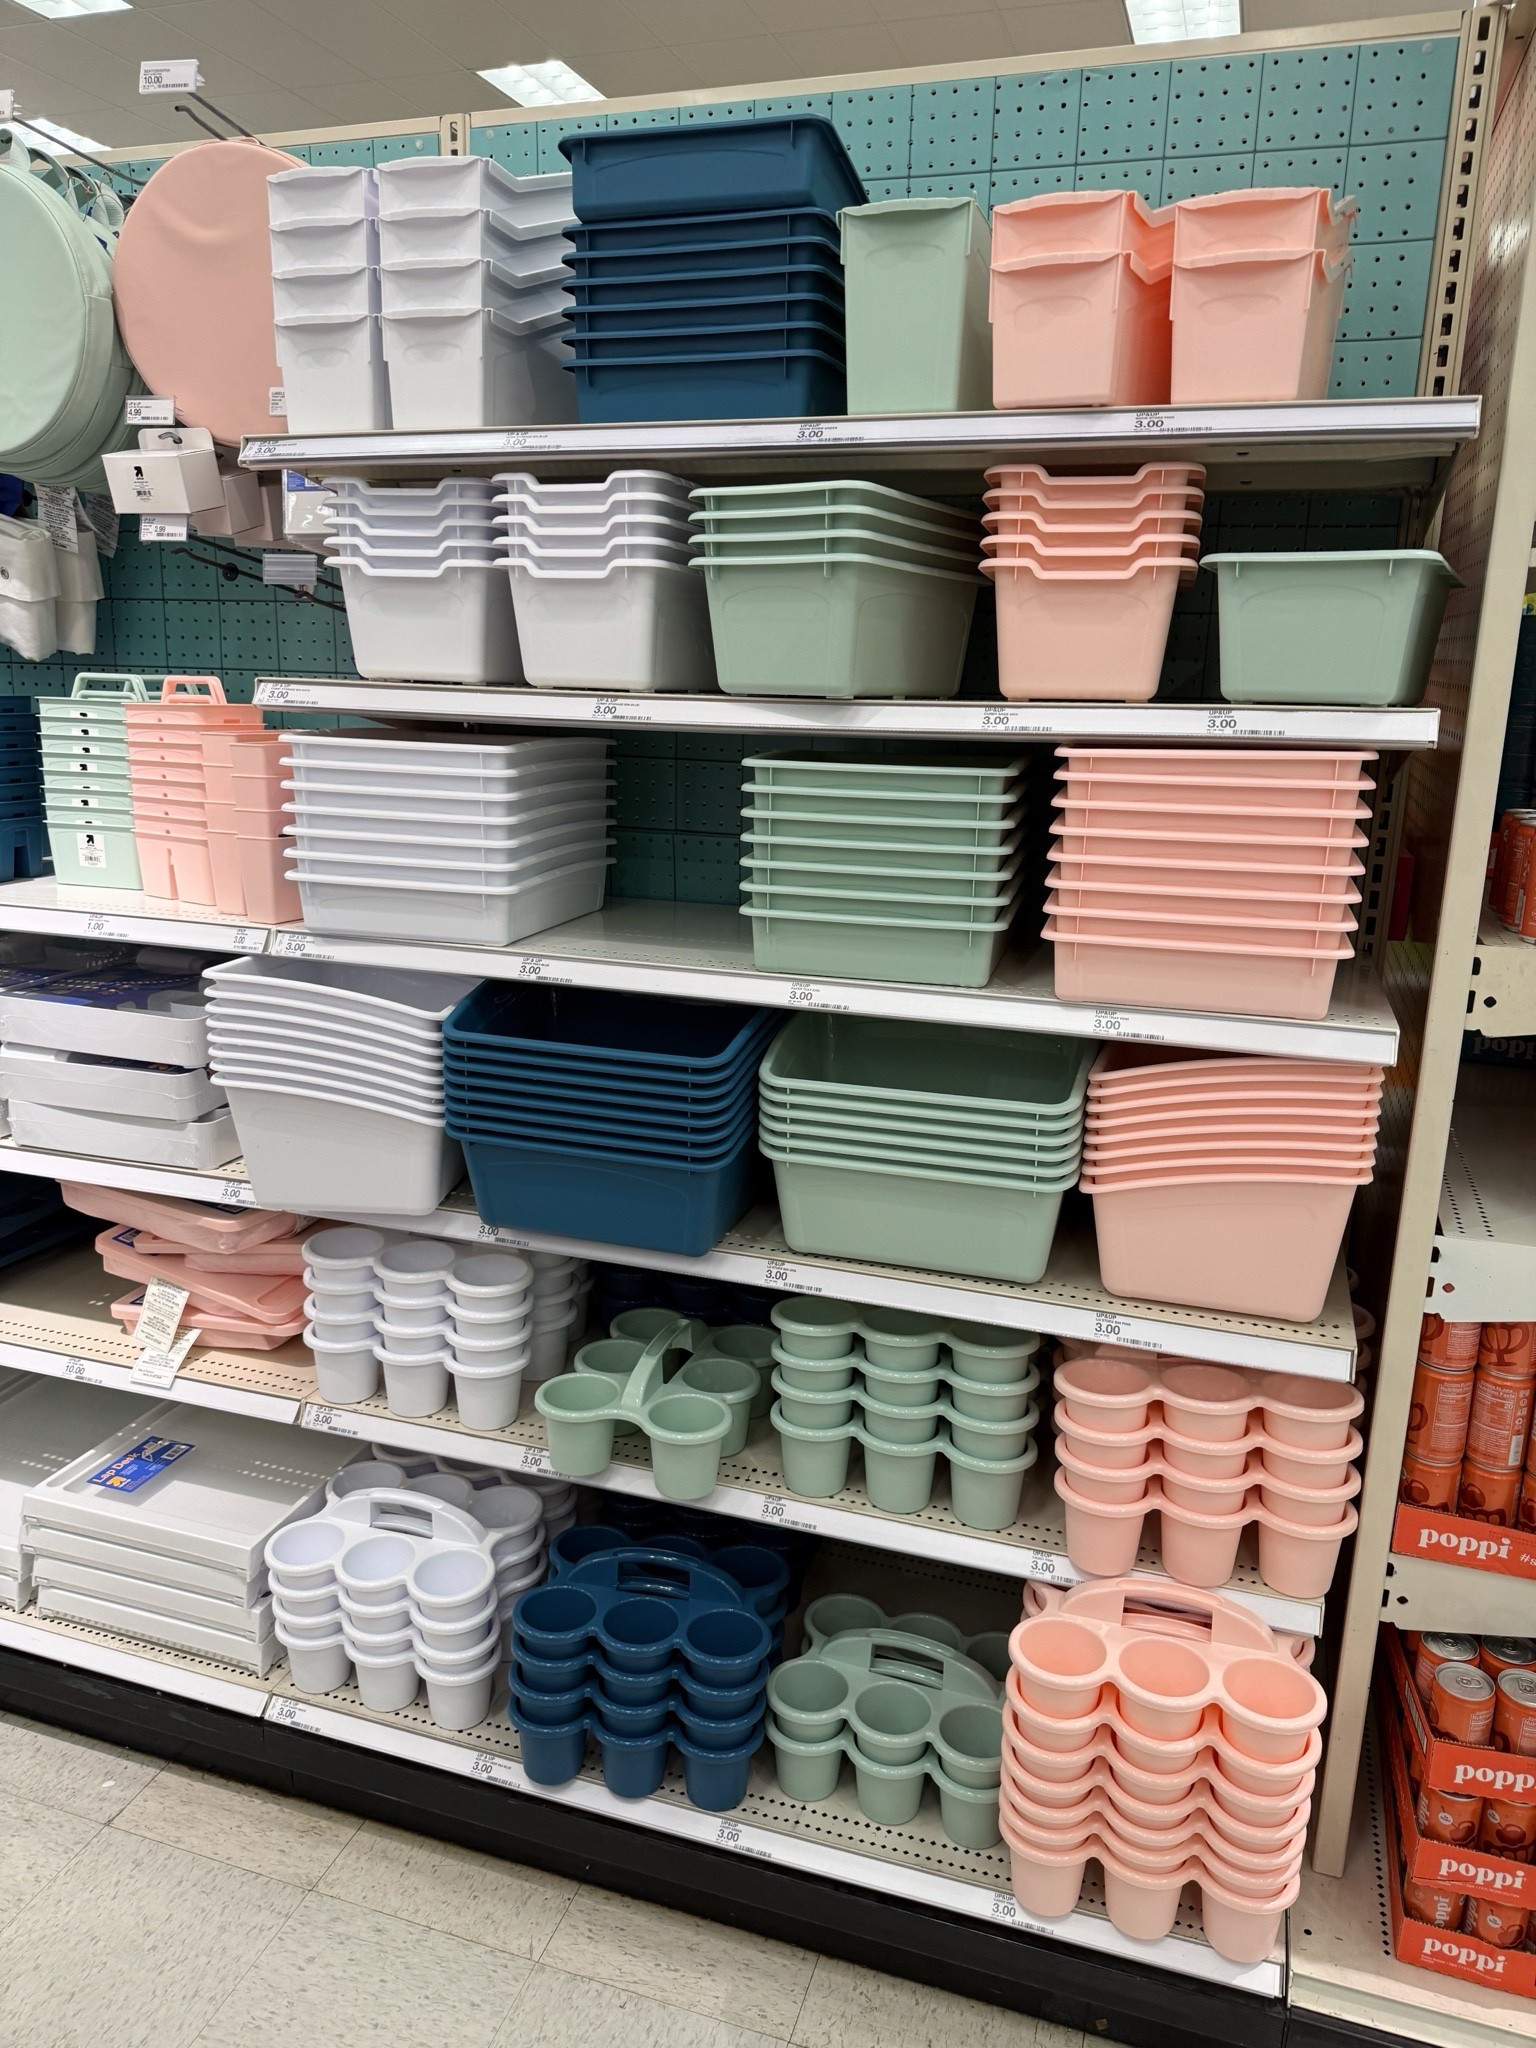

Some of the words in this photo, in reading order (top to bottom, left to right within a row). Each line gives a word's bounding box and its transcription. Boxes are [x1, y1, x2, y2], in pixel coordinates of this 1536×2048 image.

[144, 76, 163, 84] 10.00
[1134, 420, 1164, 428] 3.00
[797, 430, 823, 438] 3.00
[268, 690, 289, 699] 3.00
[594, 706, 617, 714] 3.00
[982, 716, 1009, 725] 3.00
[1207, 719, 1237, 728] 3.00
[88, 922, 104, 930] 1.00
[234, 936, 245, 944] 3.00
[286, 943, 305, 951] 3.00
[520, 965, 540, 975] 3.00
[790, 991, 812, 1000] 3.00
[1094, 1019, 1120, 1030] 3.00
[222, 1188, 240, 1198] 3.00
[479, 1225, 499, 1236] 3.00
[766, 1269, 788, 1281] 3.00
[1095, 1322, 1120, 1335] 3.00
[65, 1364, 85, 1375] 10.00
[314, 1414, 332, 1425] 3.00
[522, 1455, 542, 1466] 3.00
[92, 1470, 116, 1483] Lap
[114, 1452, 140, 1469] Desk
[763, 1504, 784, 1516] 3.00
[1418, 1528, 1510, 1560] poppi
[1031, 1560, 1055, 1573] 3.00
[278, 1707, 296, 1719] 3.00
[472, 1762, 493, 1774] 3.00
[1454, 1764, 1536, 1792] popp
[717, 1829, 740, 1842] 3.00
[1439, 1858, 1524, 1889] poppi
[992, 1903, 1016, 1917] 3.00
[1434, 1895, 1452, 1927] oppi
[1422, 1938, 1506, 1973] poppi
